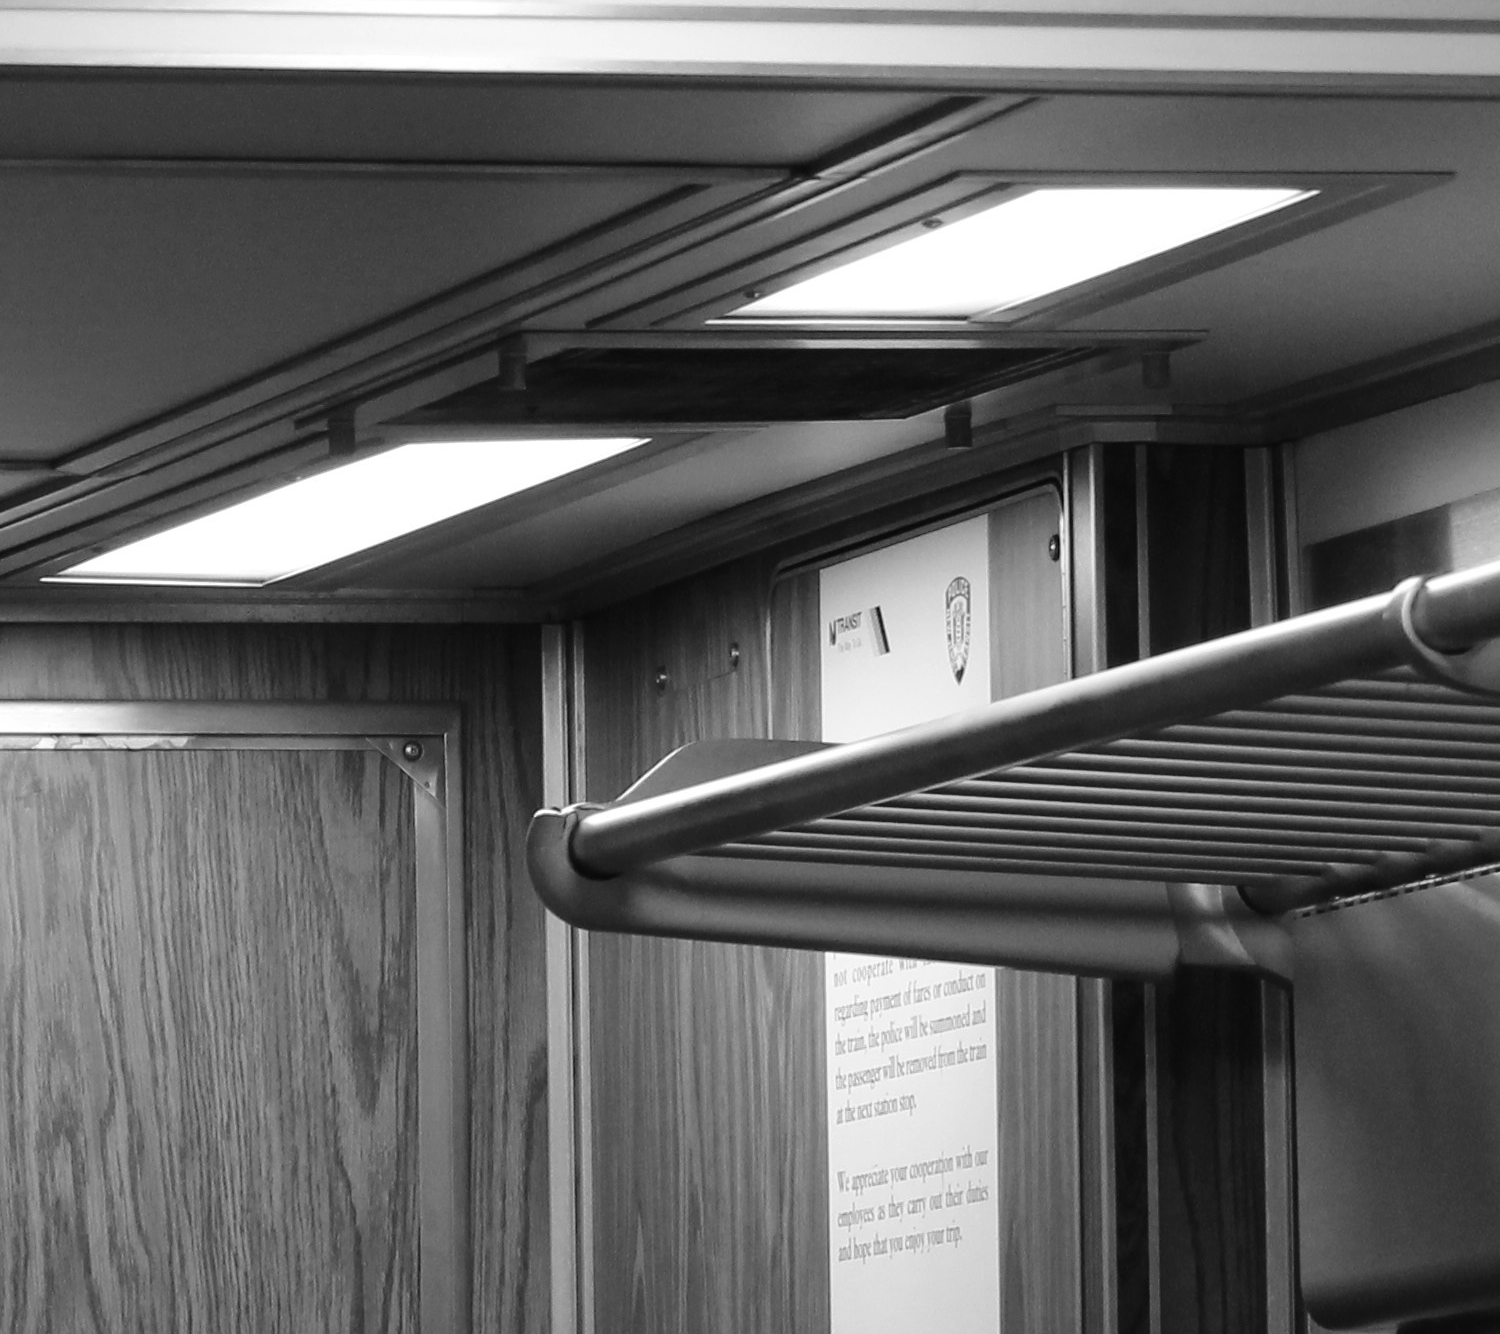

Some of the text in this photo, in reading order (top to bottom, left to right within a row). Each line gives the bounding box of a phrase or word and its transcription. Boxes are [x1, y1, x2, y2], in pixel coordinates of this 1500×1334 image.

[834, 967, 847, 987] not
[852, 960, 893, 986] cooperate
[834, 970, 986, 1025] regarding payment of fares or conduct on
[835, 1000, 986, 1056] the train, the police will be summoned and
[835, 1036, 987, 1094] the passenger will be removed from the train
[836, 1106, 843, 1124] at
[845, 1100, 855, 1122] the
[857, 1100, 873, 1119] next
[874, 1091, 898, 1117] station
[837, 1145, 989, 1196] We appreciate your cooperation with our
[838, 1179, 989, 1232] employees as they carry out their duties
[839, 1238, 852, 1261] and
[854, 1237, 872, 1265] hope
[874, 1232, 888, 1254] that
[890, 1235, 903, 1258] you
[905, 1227, 925, 1254] enjoy
[926, 1227, 945, 1253] your
